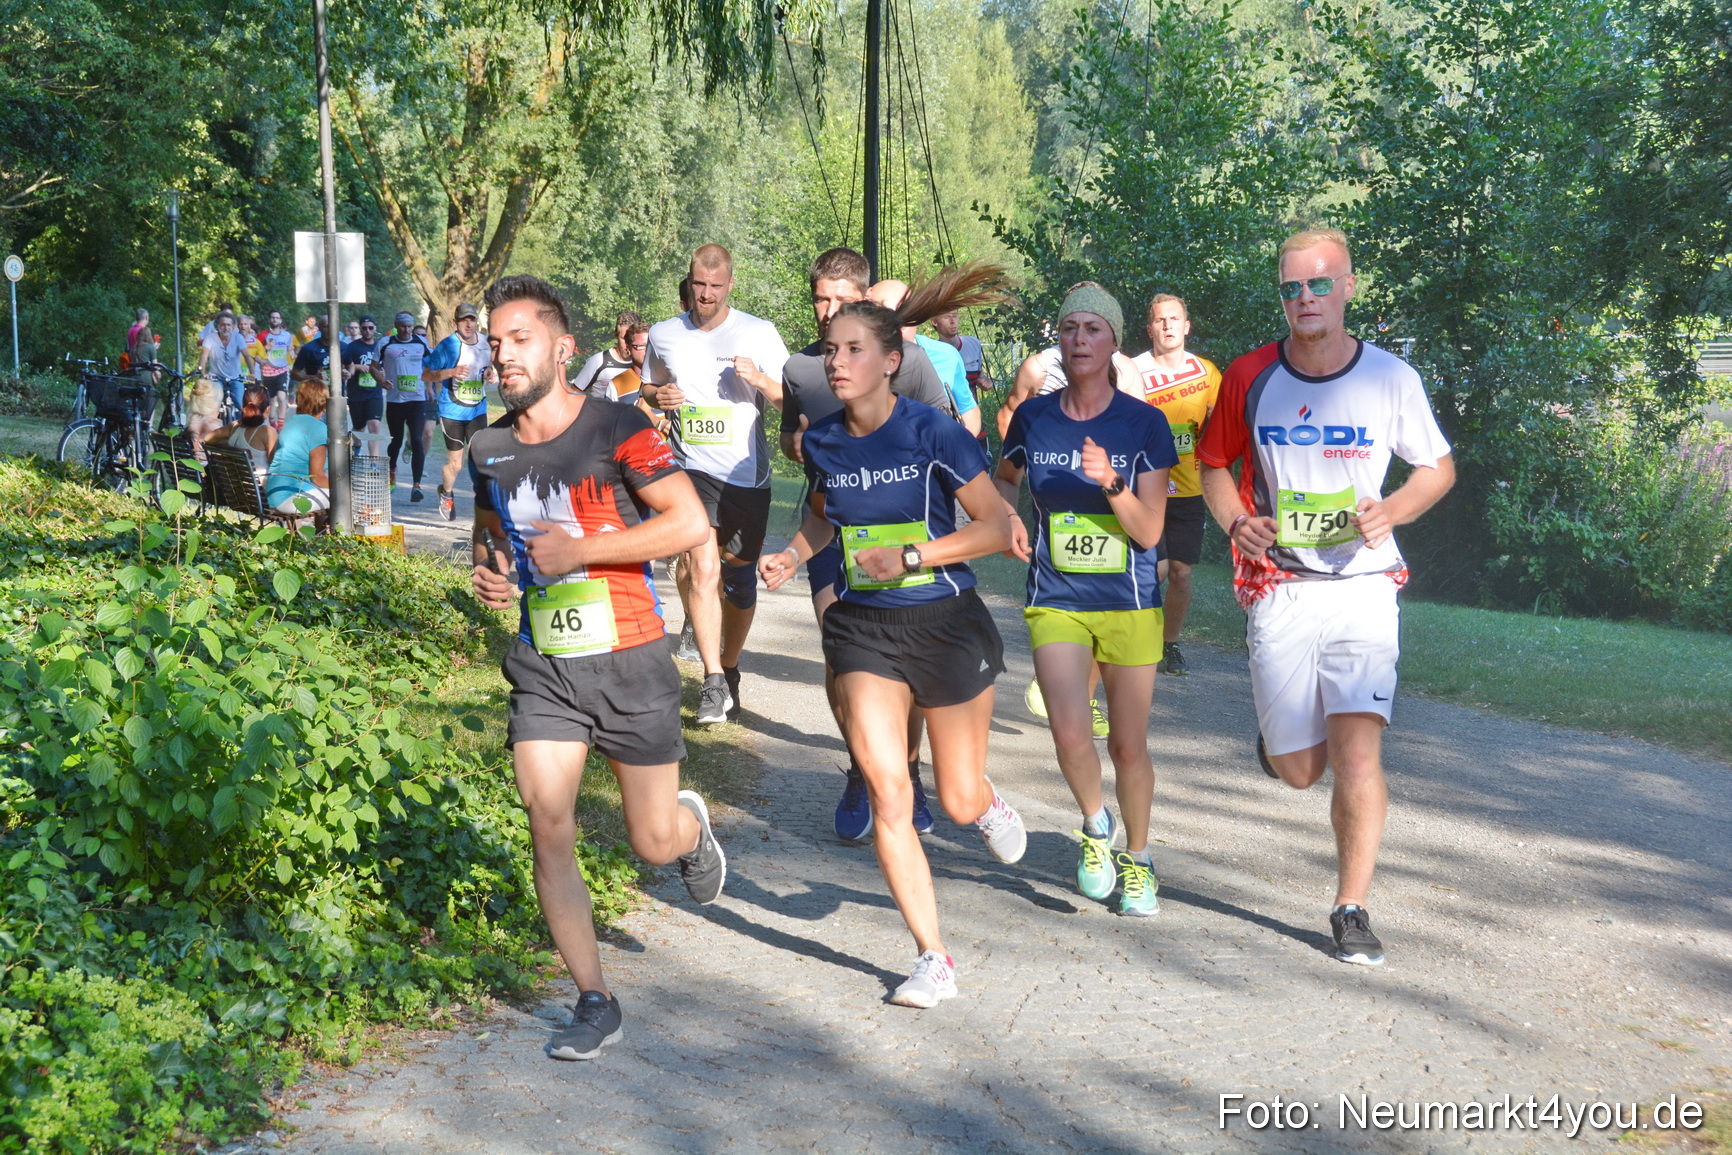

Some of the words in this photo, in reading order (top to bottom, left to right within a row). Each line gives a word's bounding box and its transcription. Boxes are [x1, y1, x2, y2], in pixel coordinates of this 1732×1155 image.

[400, 380, 416, 388] 1462
[461, 387, 482, 396] 2105
[1147, 391, 1176, 407] MAX
[1179, 380, 1210, 398] BÖGL
[686, 419, 725, 434] 1380
[1174, 432, 1191, 446] 13
[1033, 451, 1070, 466] EURO
[826, 473, 859, 488] EURO
[872, 464, 919, 485] POLES
[1288, 510, 1348, 532] 1750
[1064, 535, 1109, 556] 487
[550, 608, 582, 633] 46
